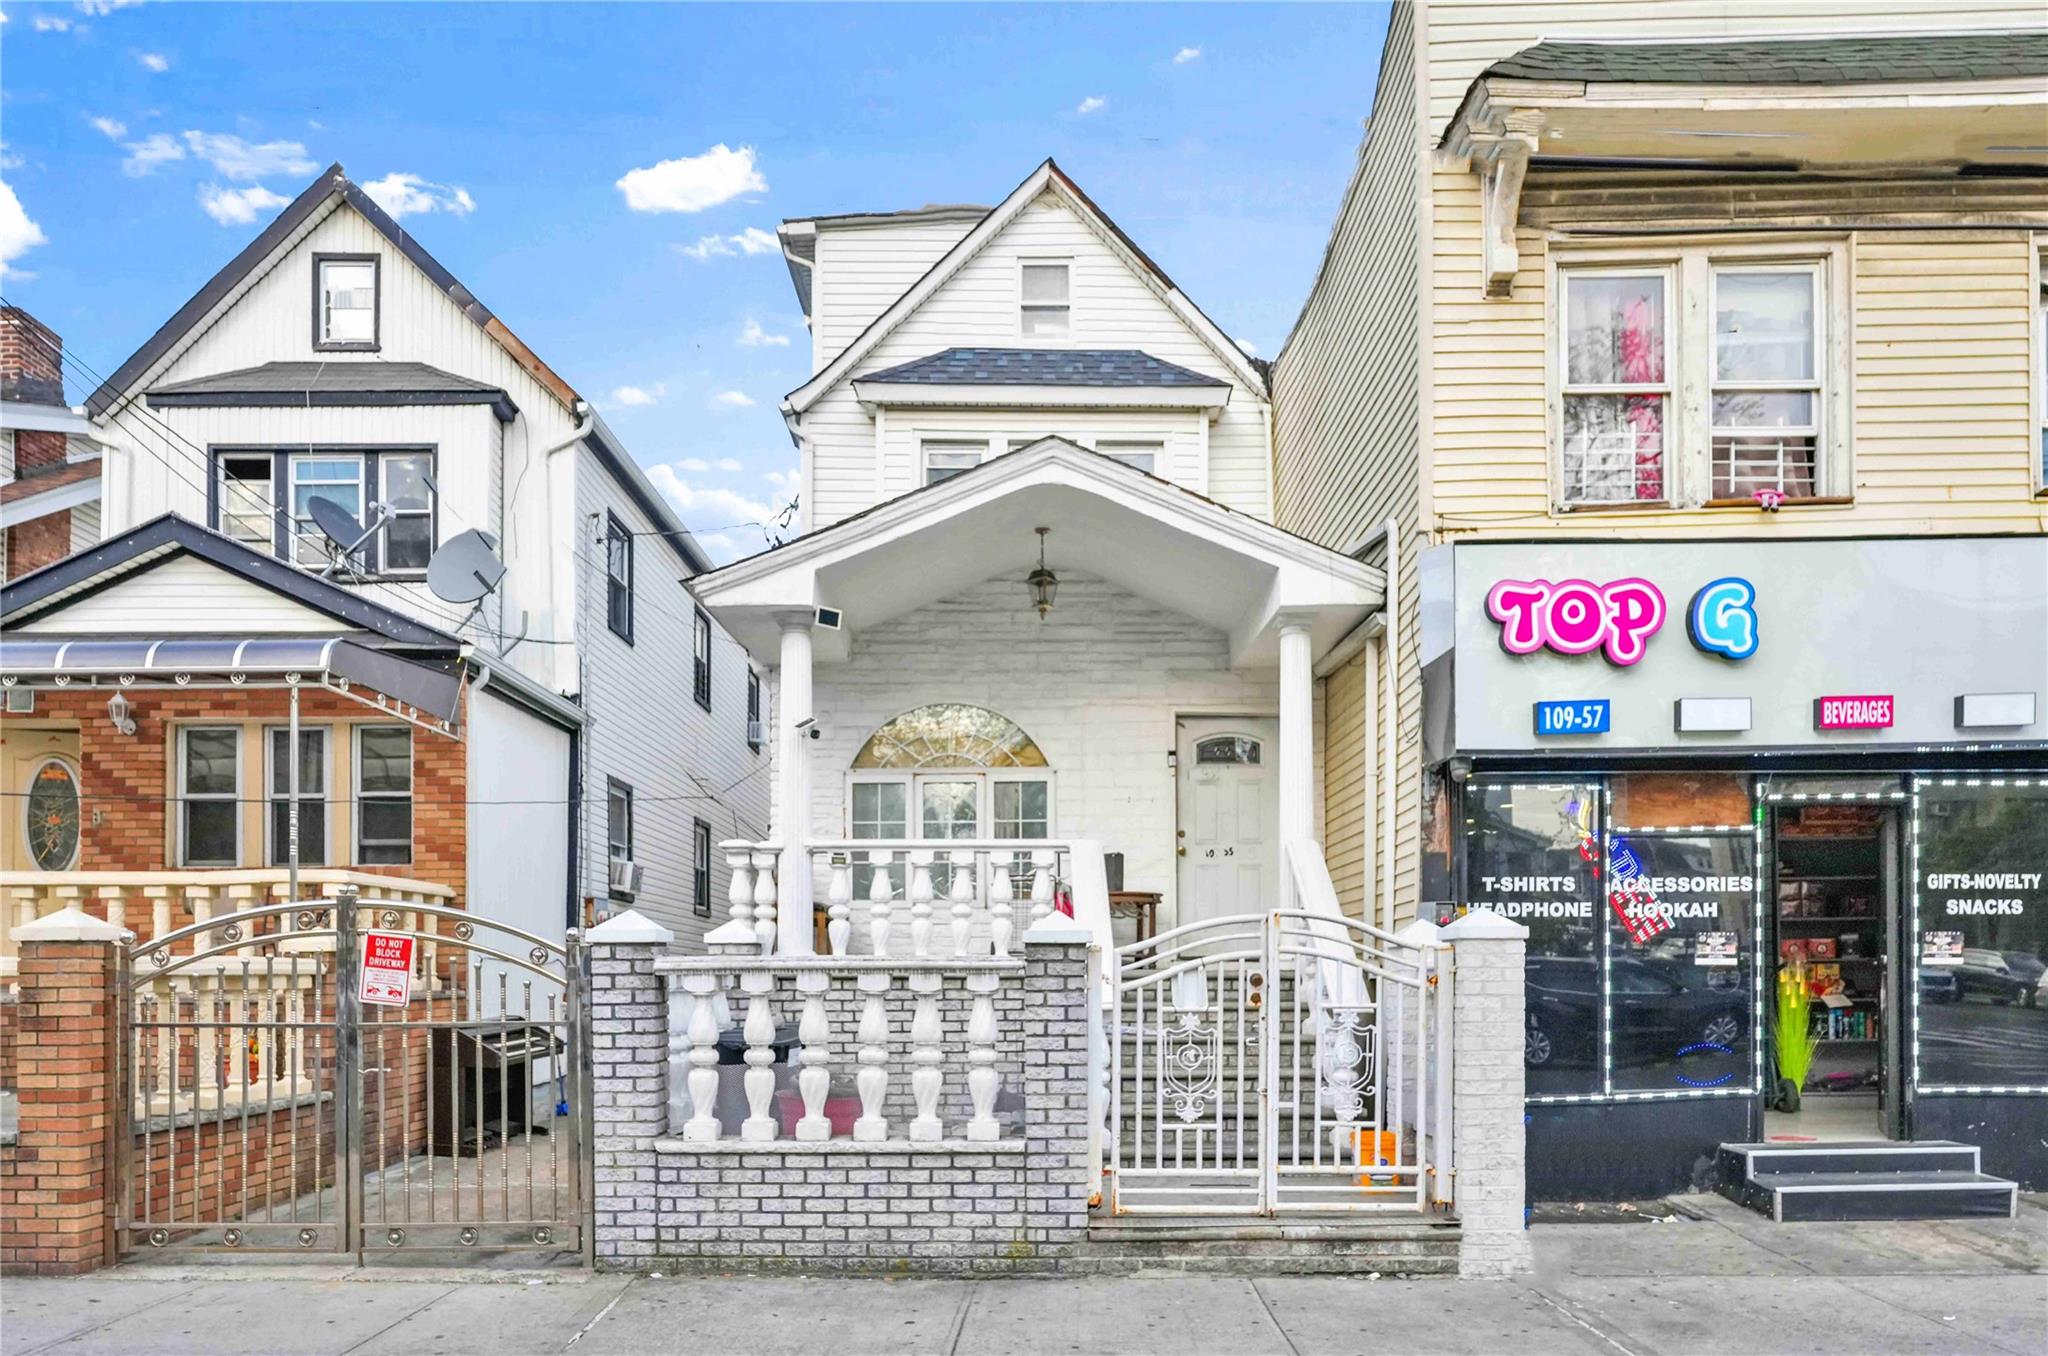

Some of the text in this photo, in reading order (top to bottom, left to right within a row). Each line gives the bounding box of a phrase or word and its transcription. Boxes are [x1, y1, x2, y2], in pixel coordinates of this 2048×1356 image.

[1486, 576, 1759, 667] TOP G
[1544, 704, 1604, 729] 109-57
[1823, 699, 1890, 725] BEVERAGES
[1481, 876, 1576, 892] T-SHIRTS
[1611, 876, 1753, 892] ACCESSORIES
[1927, 873, 2042, 889] GIFTS-NOVELTY
[1628, 902, 1718, 918] HOOKAH
[1946, 899, 2023, 915] SNACKS
[375, 938, 404, 949] DO NOT
[375, 948, 401, 958] BLOCK
[369, 957, 406, 968] DRIVEWAY
